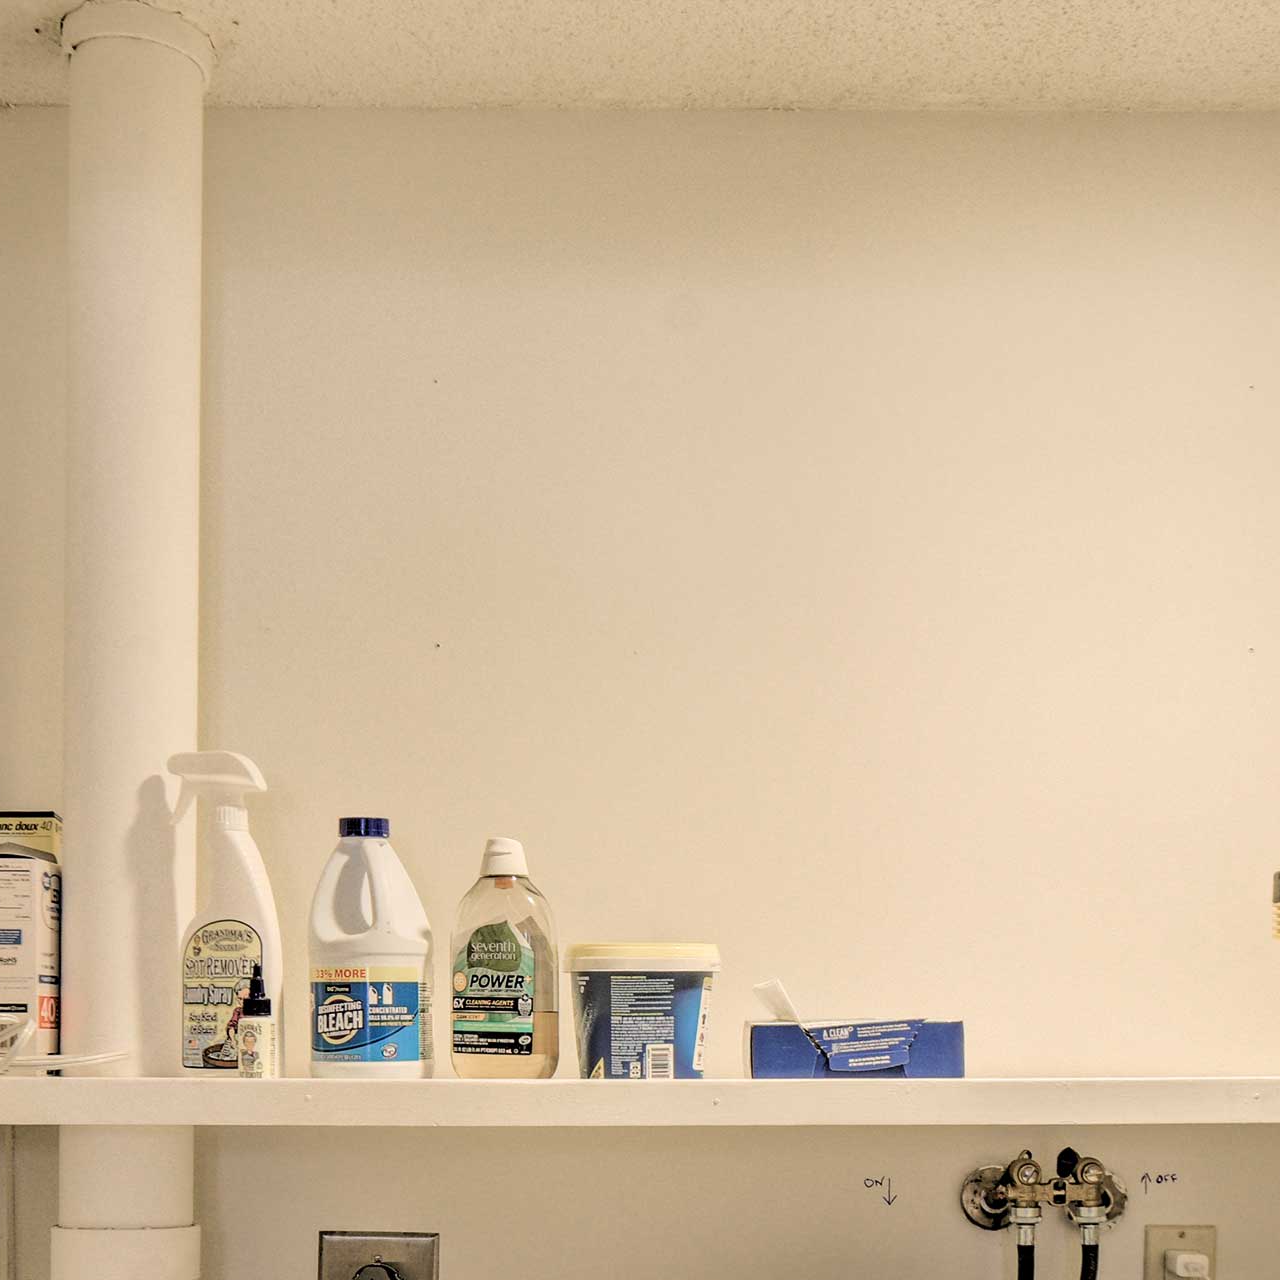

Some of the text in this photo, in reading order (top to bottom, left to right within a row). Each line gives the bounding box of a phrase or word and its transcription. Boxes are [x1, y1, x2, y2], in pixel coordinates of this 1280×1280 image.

[15, 821, 39, 832] doux
[40, 821, 53, 832] 40
[471, 941, 516, 953] seventh
[470, 951, 516, 961] generation
[334, 969, 366, 978] MORE
[40, 998, 57, 1023] 40
[317, 1010, 363, 1033] BLEACH
[829, 1027, 849, 1038] CLEAN
[863, 1176, 885, 1188] ON
[1156, 1173, 1178, 1184] OFF
